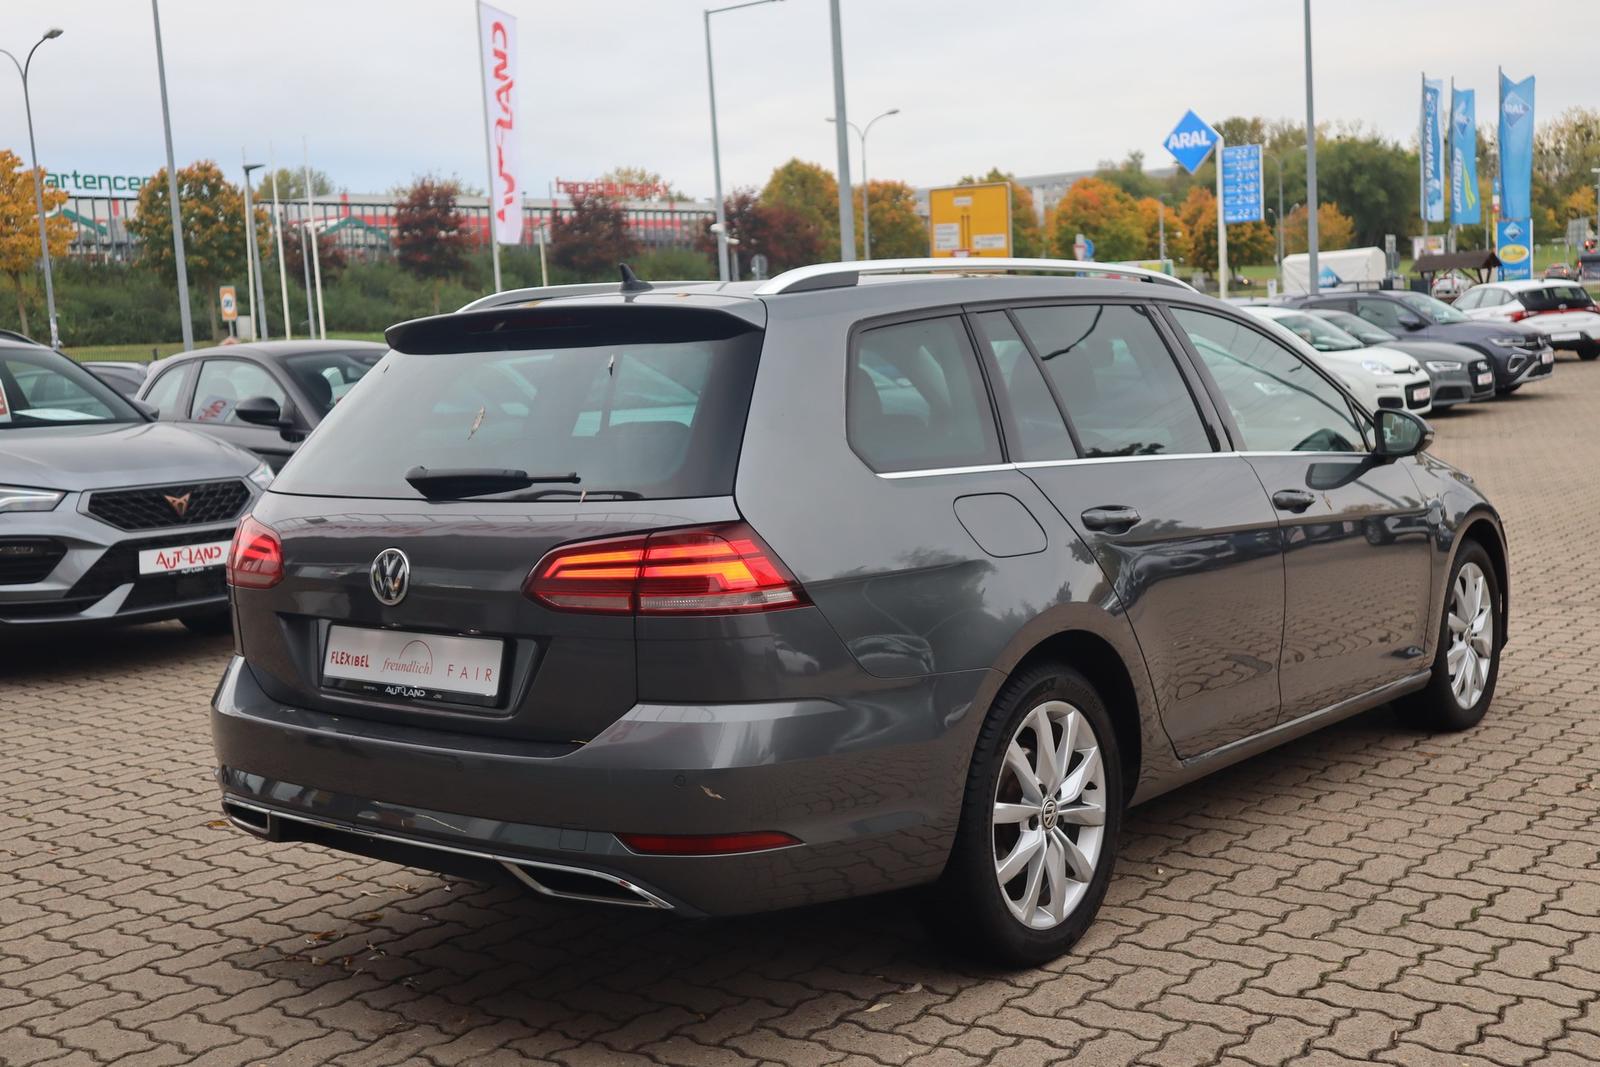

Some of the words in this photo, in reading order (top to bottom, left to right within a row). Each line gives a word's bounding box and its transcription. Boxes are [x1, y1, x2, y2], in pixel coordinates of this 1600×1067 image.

[1168, 130, 1212, 149] ARAL
[156, 546, 222, 569] AUTOLAND
[330, 651, 369, 668] FLEXIBEL
[380, 657, 430, 675] freundlich
[447, 664, 492, 682] FAIR
